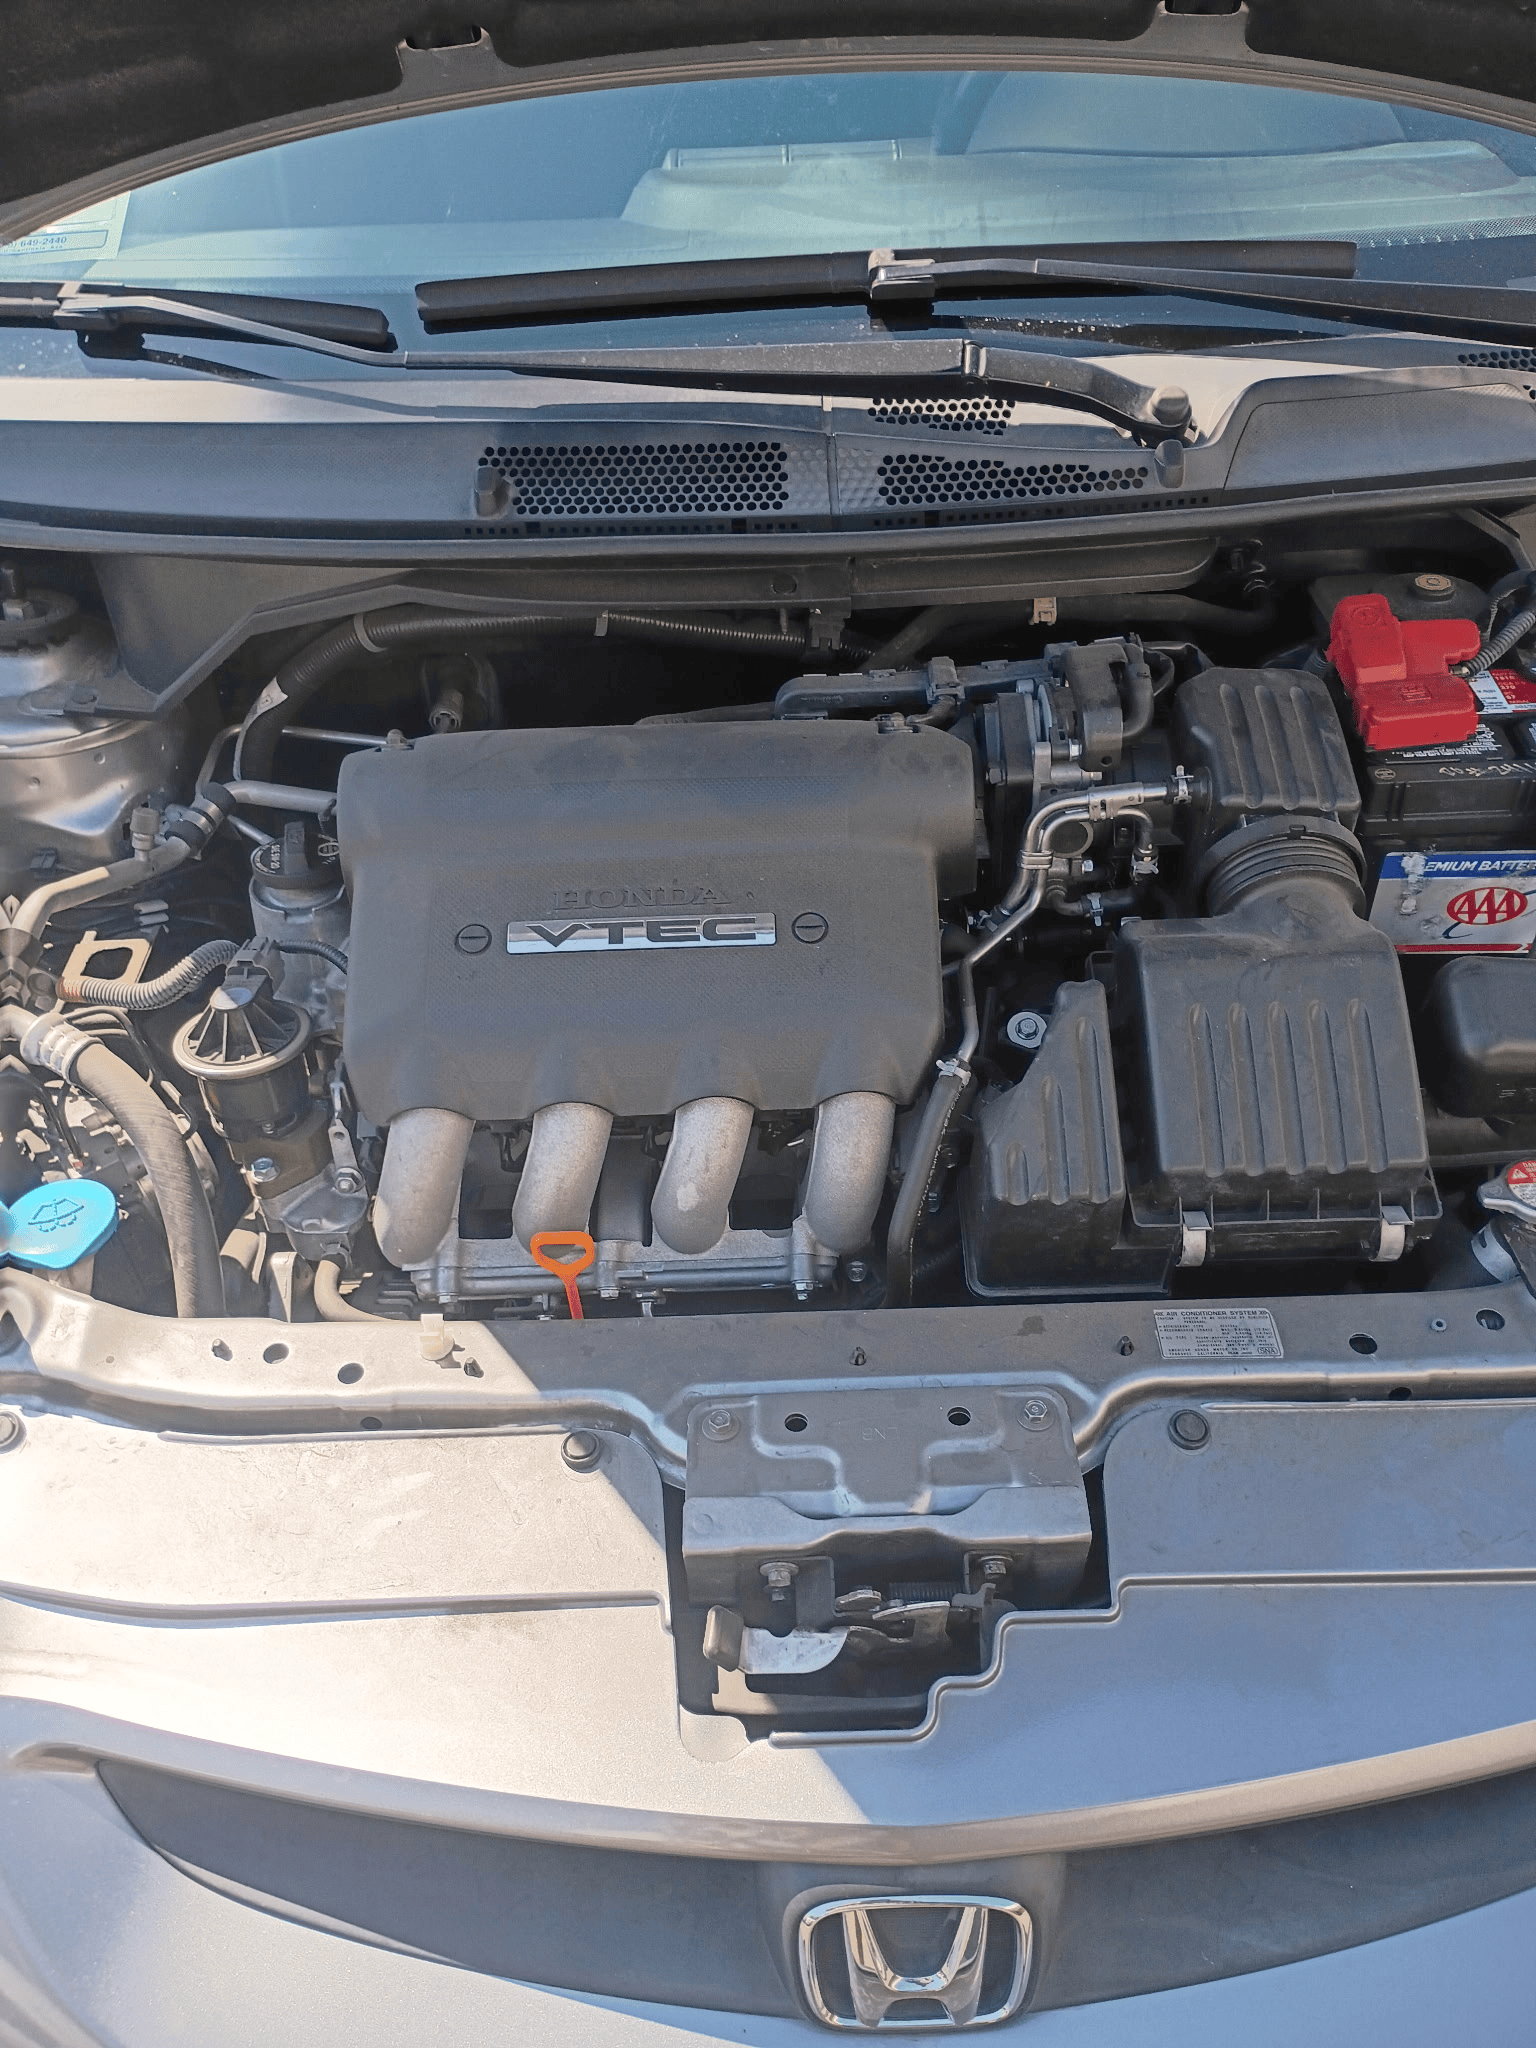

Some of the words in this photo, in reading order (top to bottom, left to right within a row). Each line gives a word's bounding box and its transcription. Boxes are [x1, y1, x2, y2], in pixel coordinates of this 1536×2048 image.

[1423, 861, 1478, 872] EMIUM
[552, 887, 732, 911] HONDA
[1447, 887, 1528, 925] AAA
[525, 916, 757, 948] VTEC
